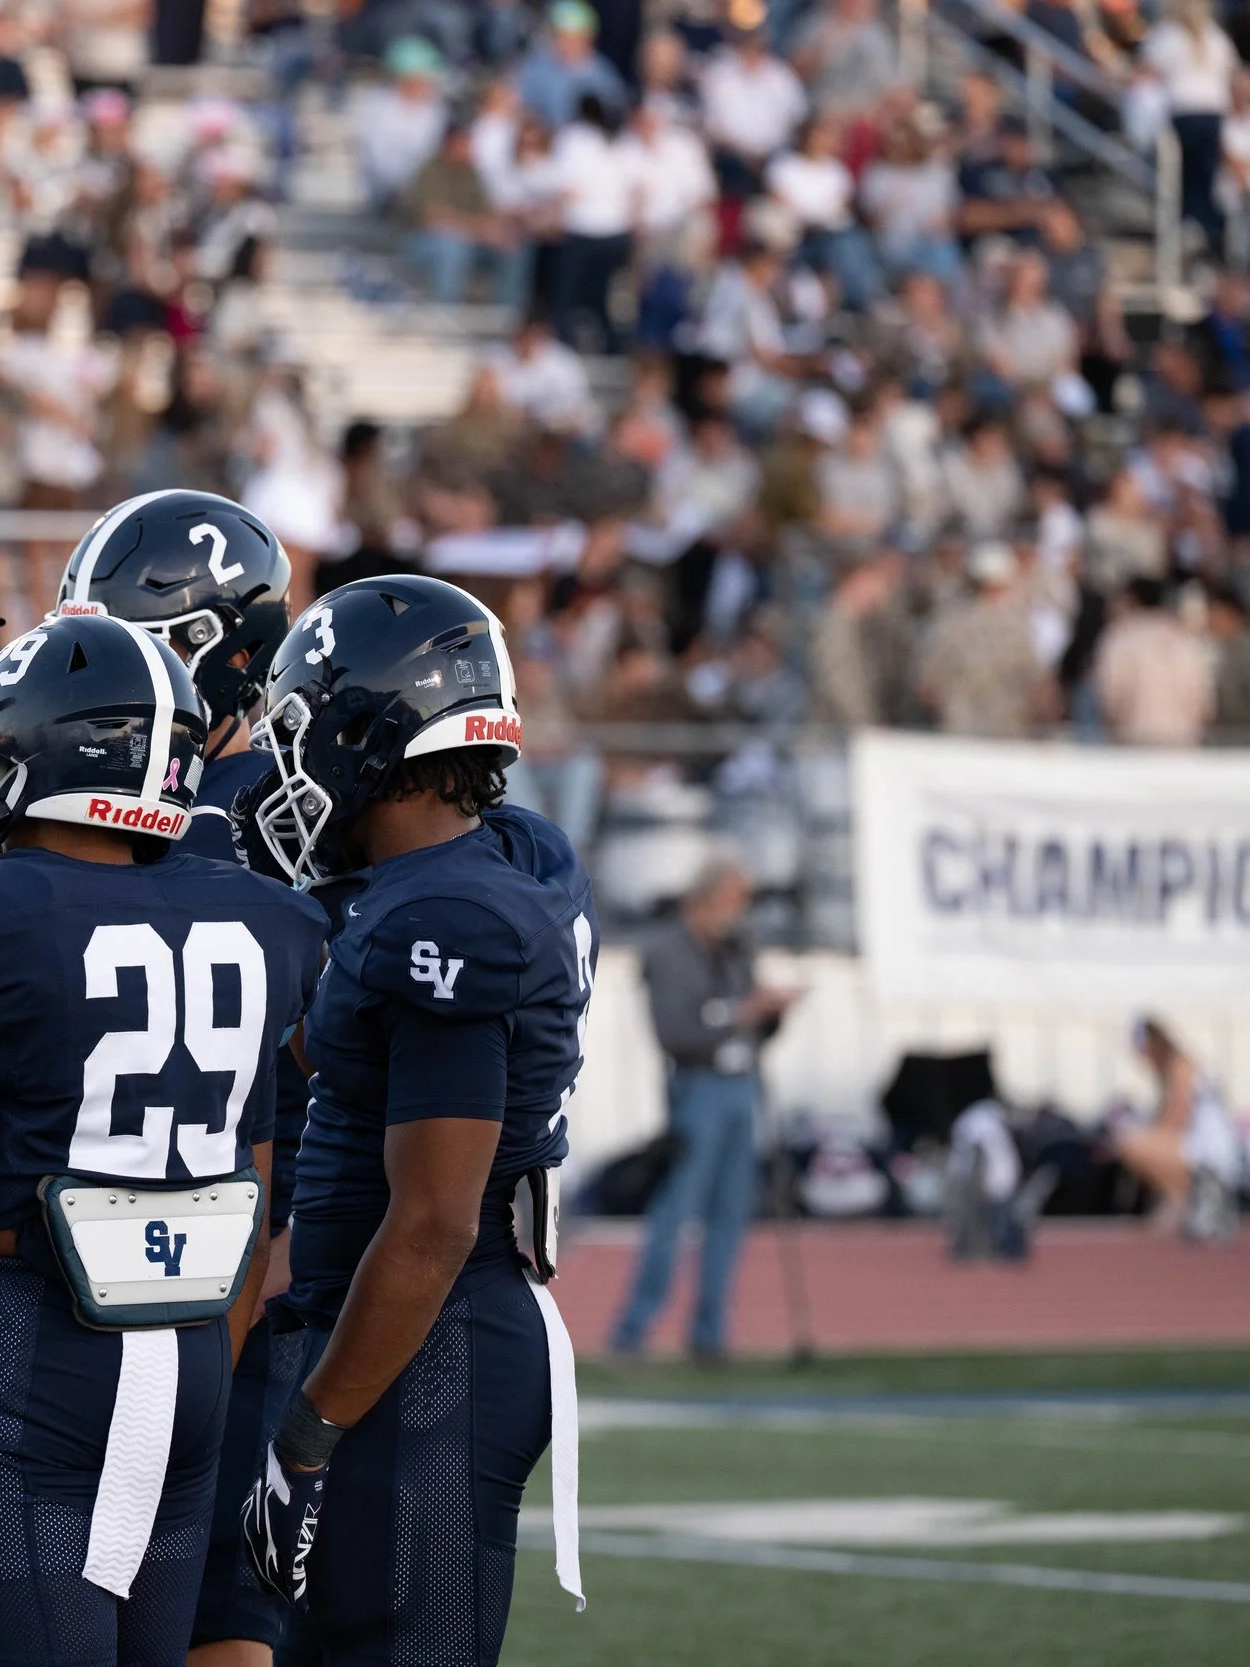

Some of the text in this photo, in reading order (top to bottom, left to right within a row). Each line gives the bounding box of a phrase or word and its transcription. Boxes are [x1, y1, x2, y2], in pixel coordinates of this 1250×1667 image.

[189, 522, 245, 586] 2
[62, 603, 98, 616] Riddell
[302, 607, 336, 665] 3
[88, 798, 185, 836] Riddell
[409, 940, 464, 999] SV
[68, 921, 267, 1179] 29
[145, 1220, 187, 1277] SV
